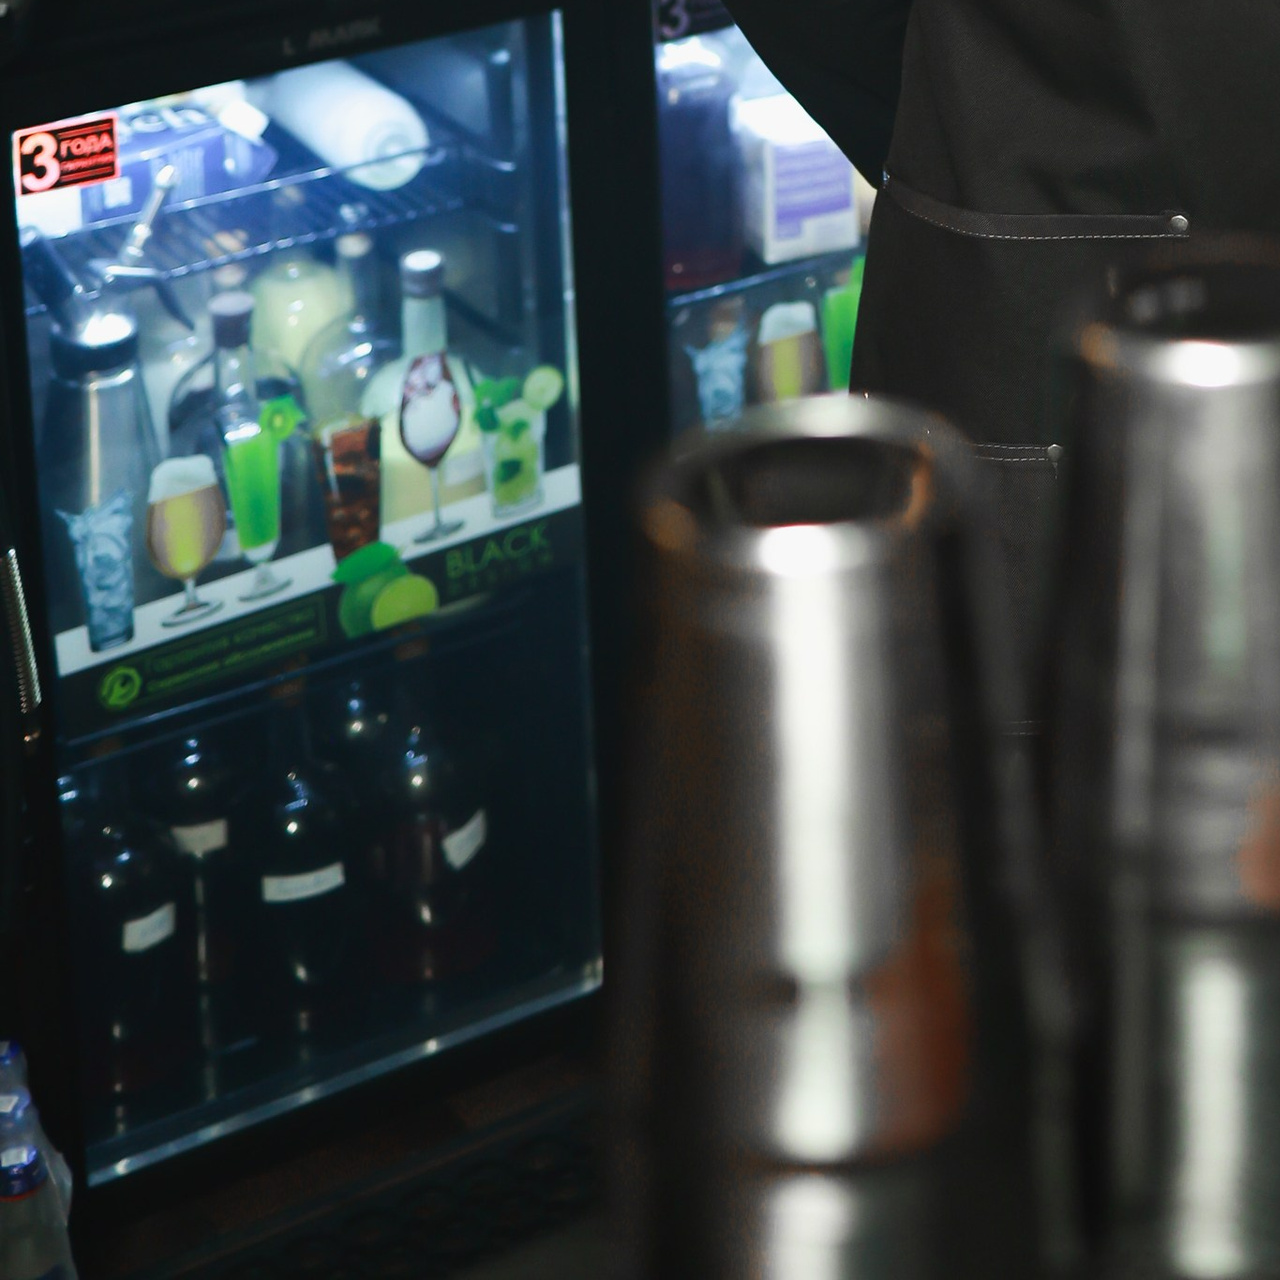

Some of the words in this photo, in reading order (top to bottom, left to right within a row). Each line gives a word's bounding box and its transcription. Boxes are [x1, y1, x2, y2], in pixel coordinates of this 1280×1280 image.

[20, 131, 61, 193] 3
[60, 131, 114, 159] ГОДА
[445, 520, 550, 580] BLACK
